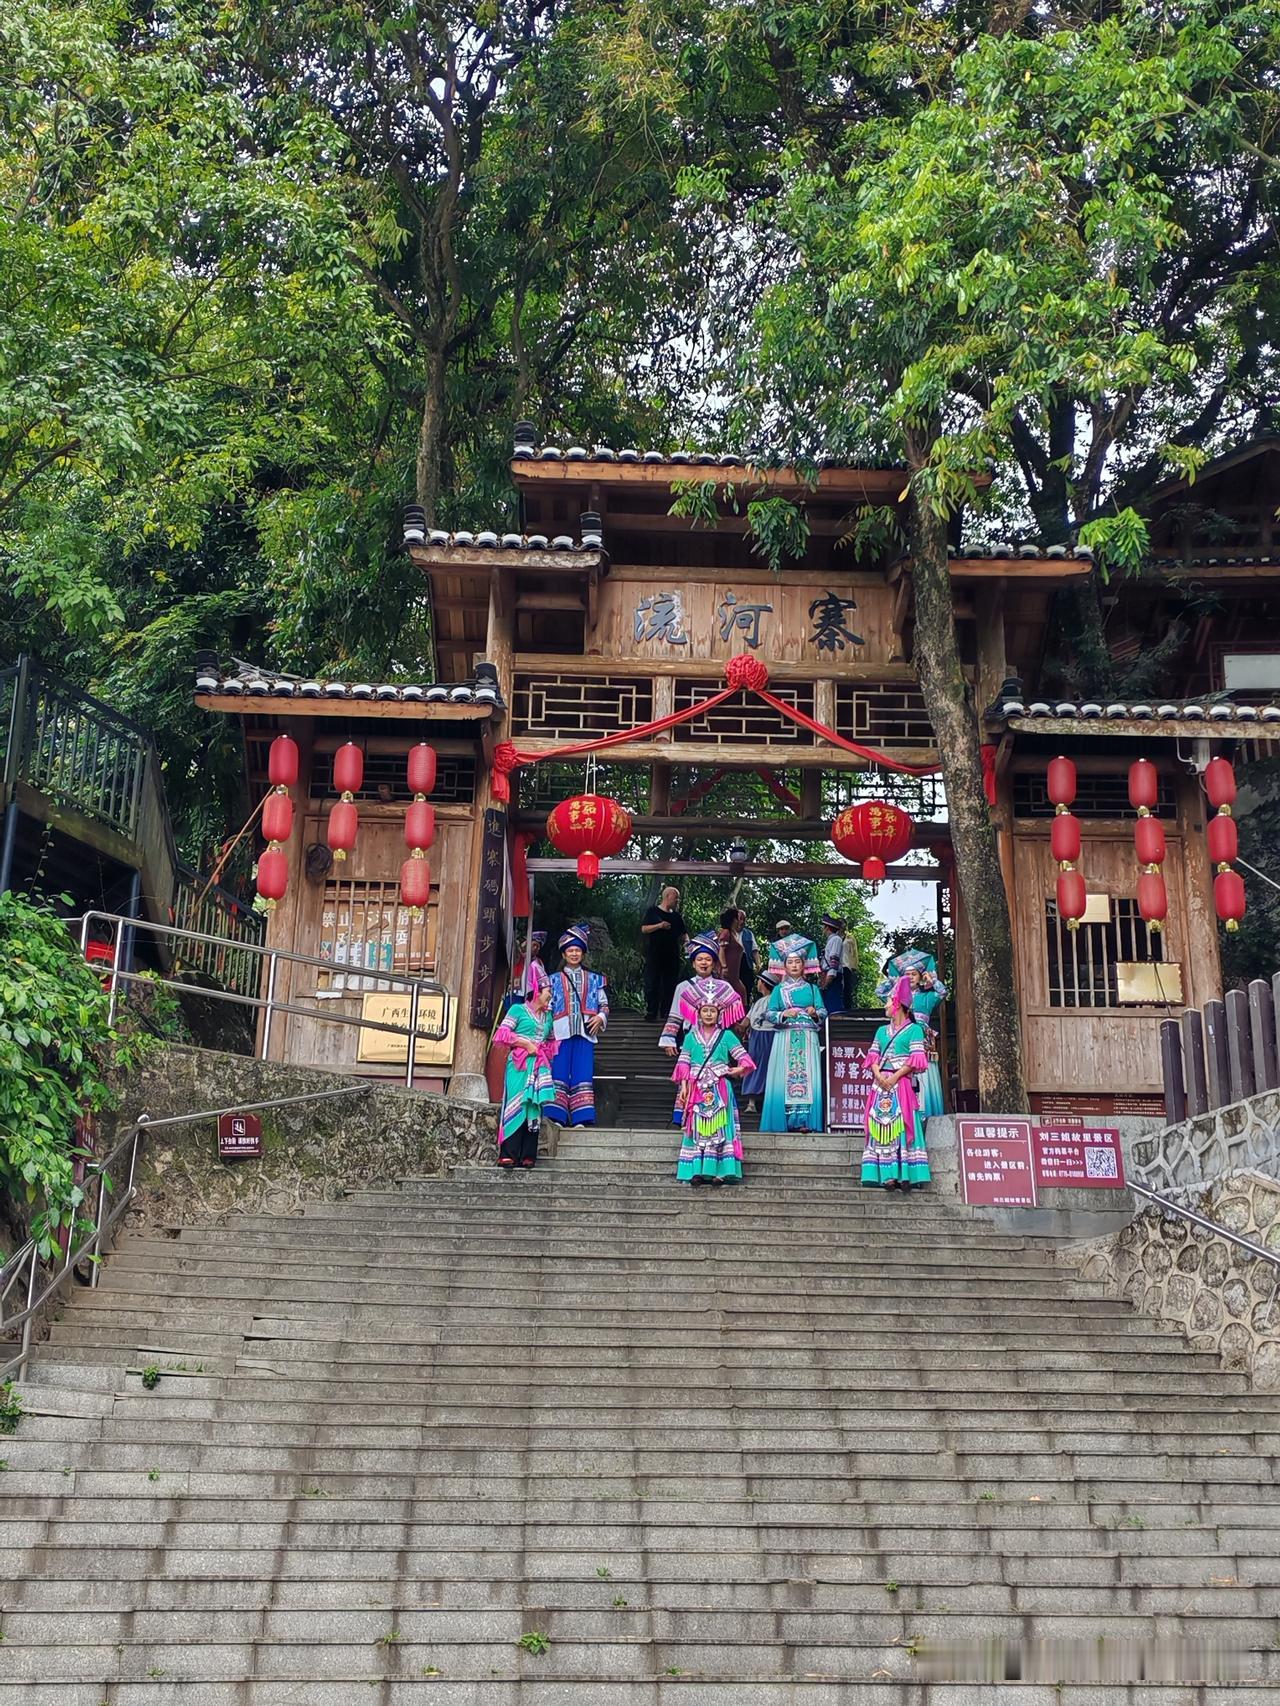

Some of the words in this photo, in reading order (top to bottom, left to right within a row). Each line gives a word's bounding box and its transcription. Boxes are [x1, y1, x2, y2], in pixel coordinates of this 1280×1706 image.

[633, 590, 866, 650] 流河寨
[381, 1006, 437, 1020] 广西生环境
[974, 1127, 1019, 1138] 温馨提示
[1039, 1132, 1113, 1143] 刘三姐故里景区
